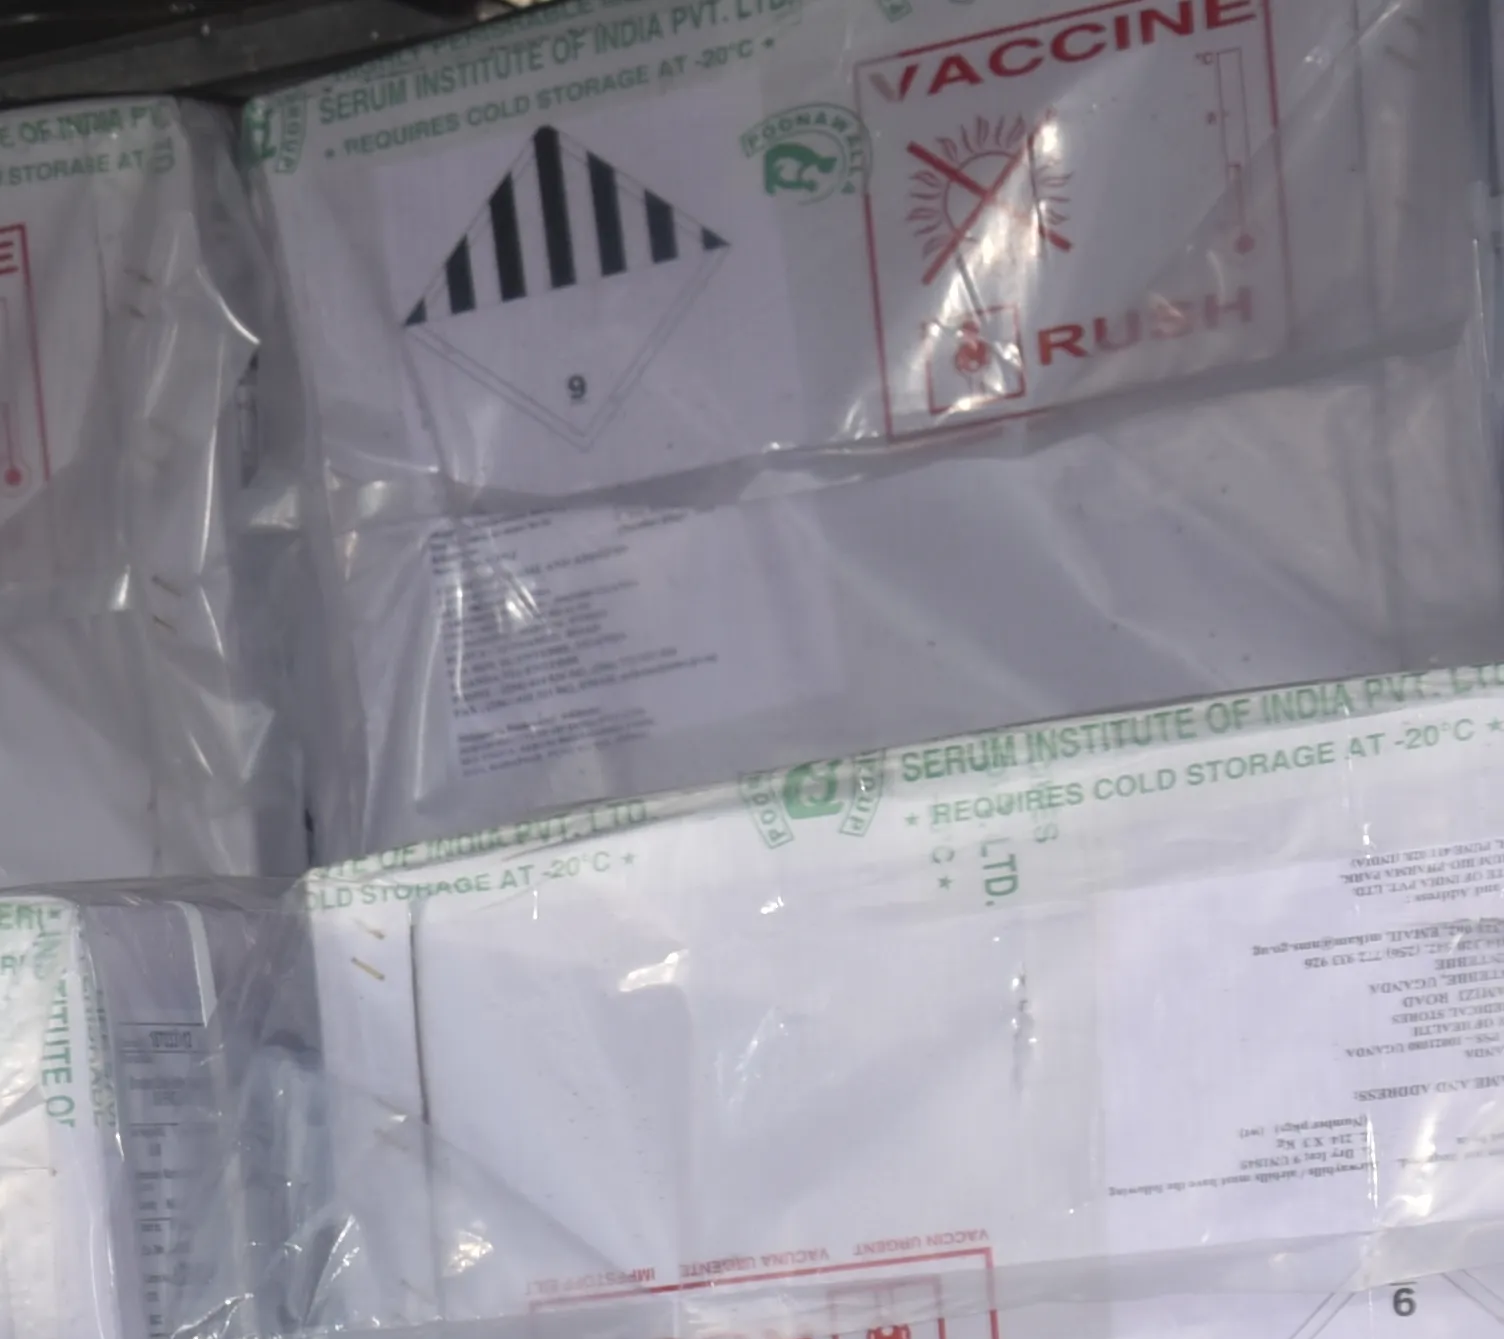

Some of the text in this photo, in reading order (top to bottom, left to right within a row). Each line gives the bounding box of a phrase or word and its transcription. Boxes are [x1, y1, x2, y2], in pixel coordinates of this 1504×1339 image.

[567, 373, 588, 402] 9
[1095, 765, 1176, 802] COLD
[1186, 740, 1335, 788] STORAGE
[1345, 731, 1386, 765] AT
[1395, 717, 1475, 757] -20°C
